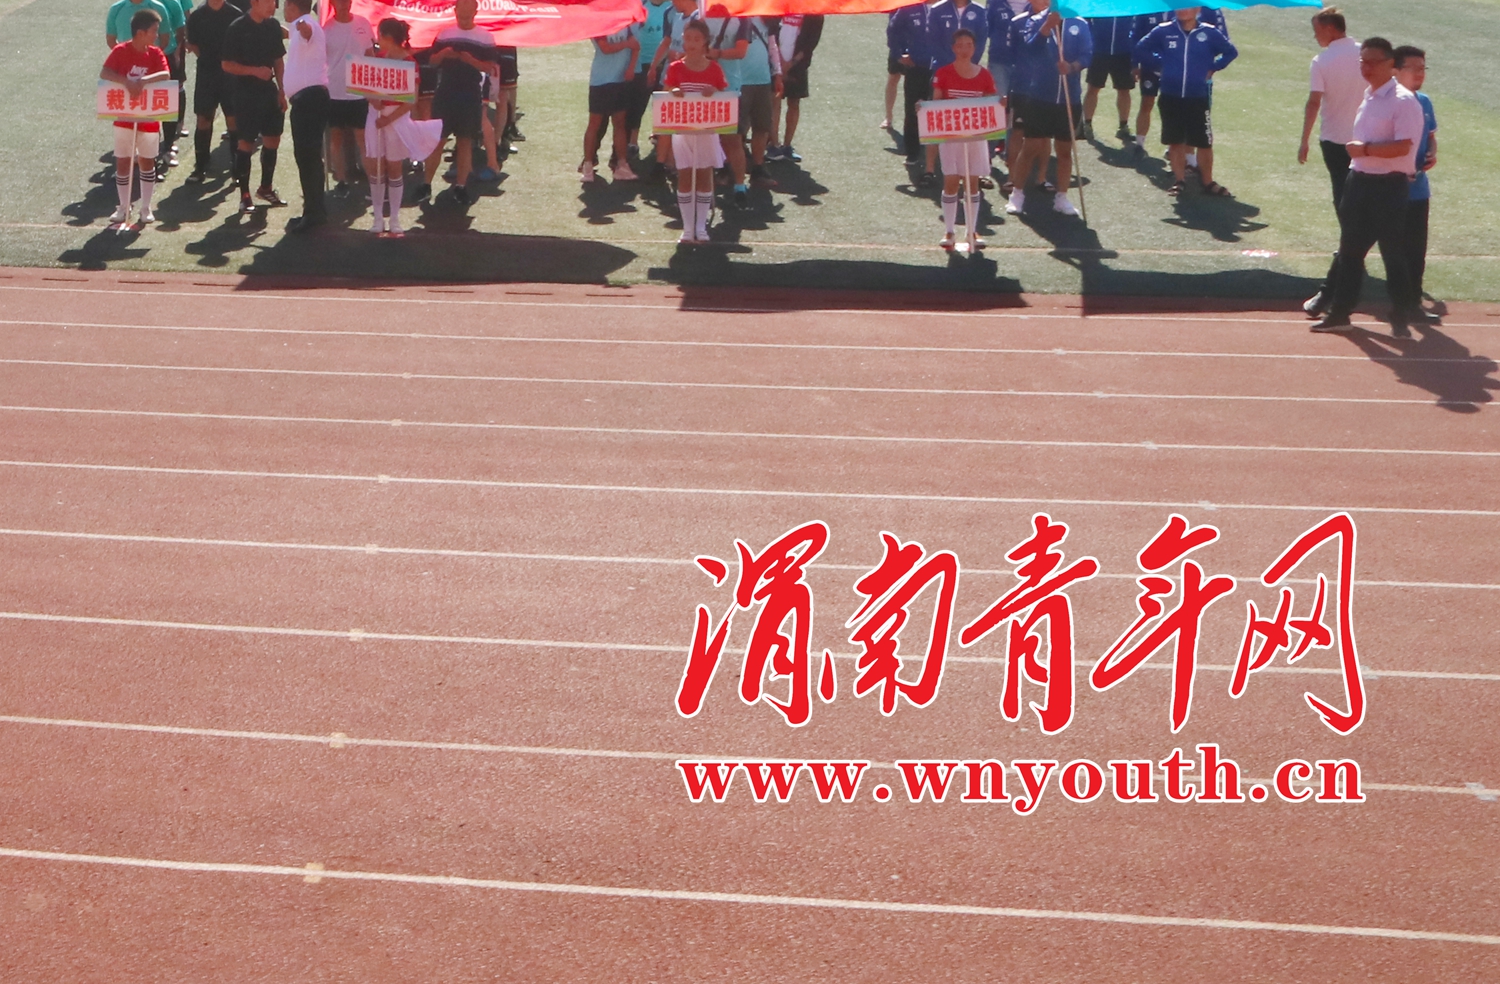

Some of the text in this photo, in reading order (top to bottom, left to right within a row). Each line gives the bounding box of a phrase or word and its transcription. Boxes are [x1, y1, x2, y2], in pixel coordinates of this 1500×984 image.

[131, 64, 149, 75] NIKE
[106, 88, 170, 112] 裁判员
[926, 105, 998, 133] 韩城蓝宝石足球队
